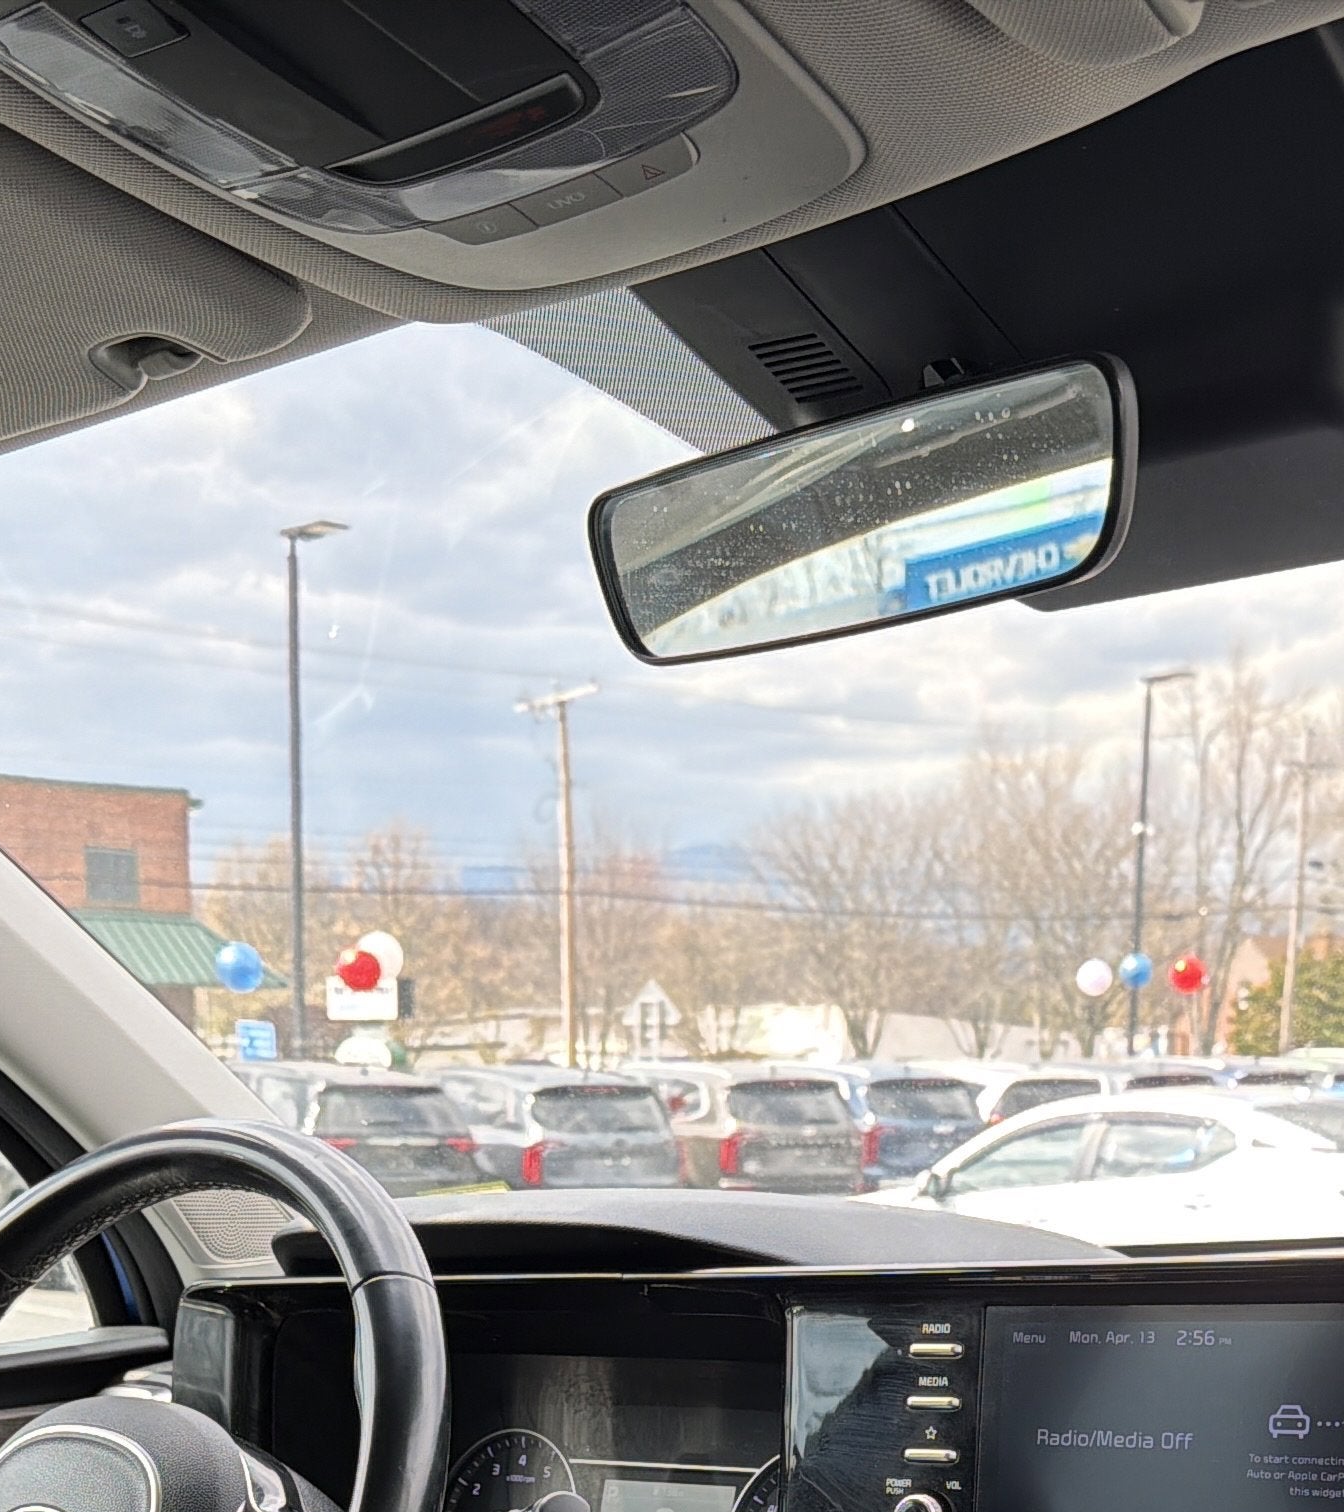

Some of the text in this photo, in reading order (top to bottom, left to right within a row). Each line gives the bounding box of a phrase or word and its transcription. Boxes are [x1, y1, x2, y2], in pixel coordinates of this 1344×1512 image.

[921, 1323, 950, 1334] RADIO
[1012, 1332, 1046, 1343] Menu
[1106, 1332, 1134, 1346] Apr.
[1139, 1331, 1156, 1344] 13
[1177, 1330, 1215, 1346] 2:56
[1219, 1337, 1232, 1345] PM
[918, 1377, 949, 1387] MEDIA
[1037, 1429, 1194, 1449] Radio/Media Off
[518, 1454, 527, 1467] 4
[1249, 1453, 1260, 1464] To
[1263, 1454, 1290, 1465] start
[491, 1463, 501, 1476] 3
[543, 1465, 552, 1479] 5
[1246, 1469, 1271, 1480] Auto
[1273, 1472, 1285, 1480] or
[1288, 1469, 1318, 1483] Apple
[886, 1478, 912, 1488] POWER
[946, 1480, 962, 1490] VOL
[472, 1483, 481, 1496] 2
[886, 1487, 904, 1495] PUSH
[1289, 1487, 1309, 1497] this
